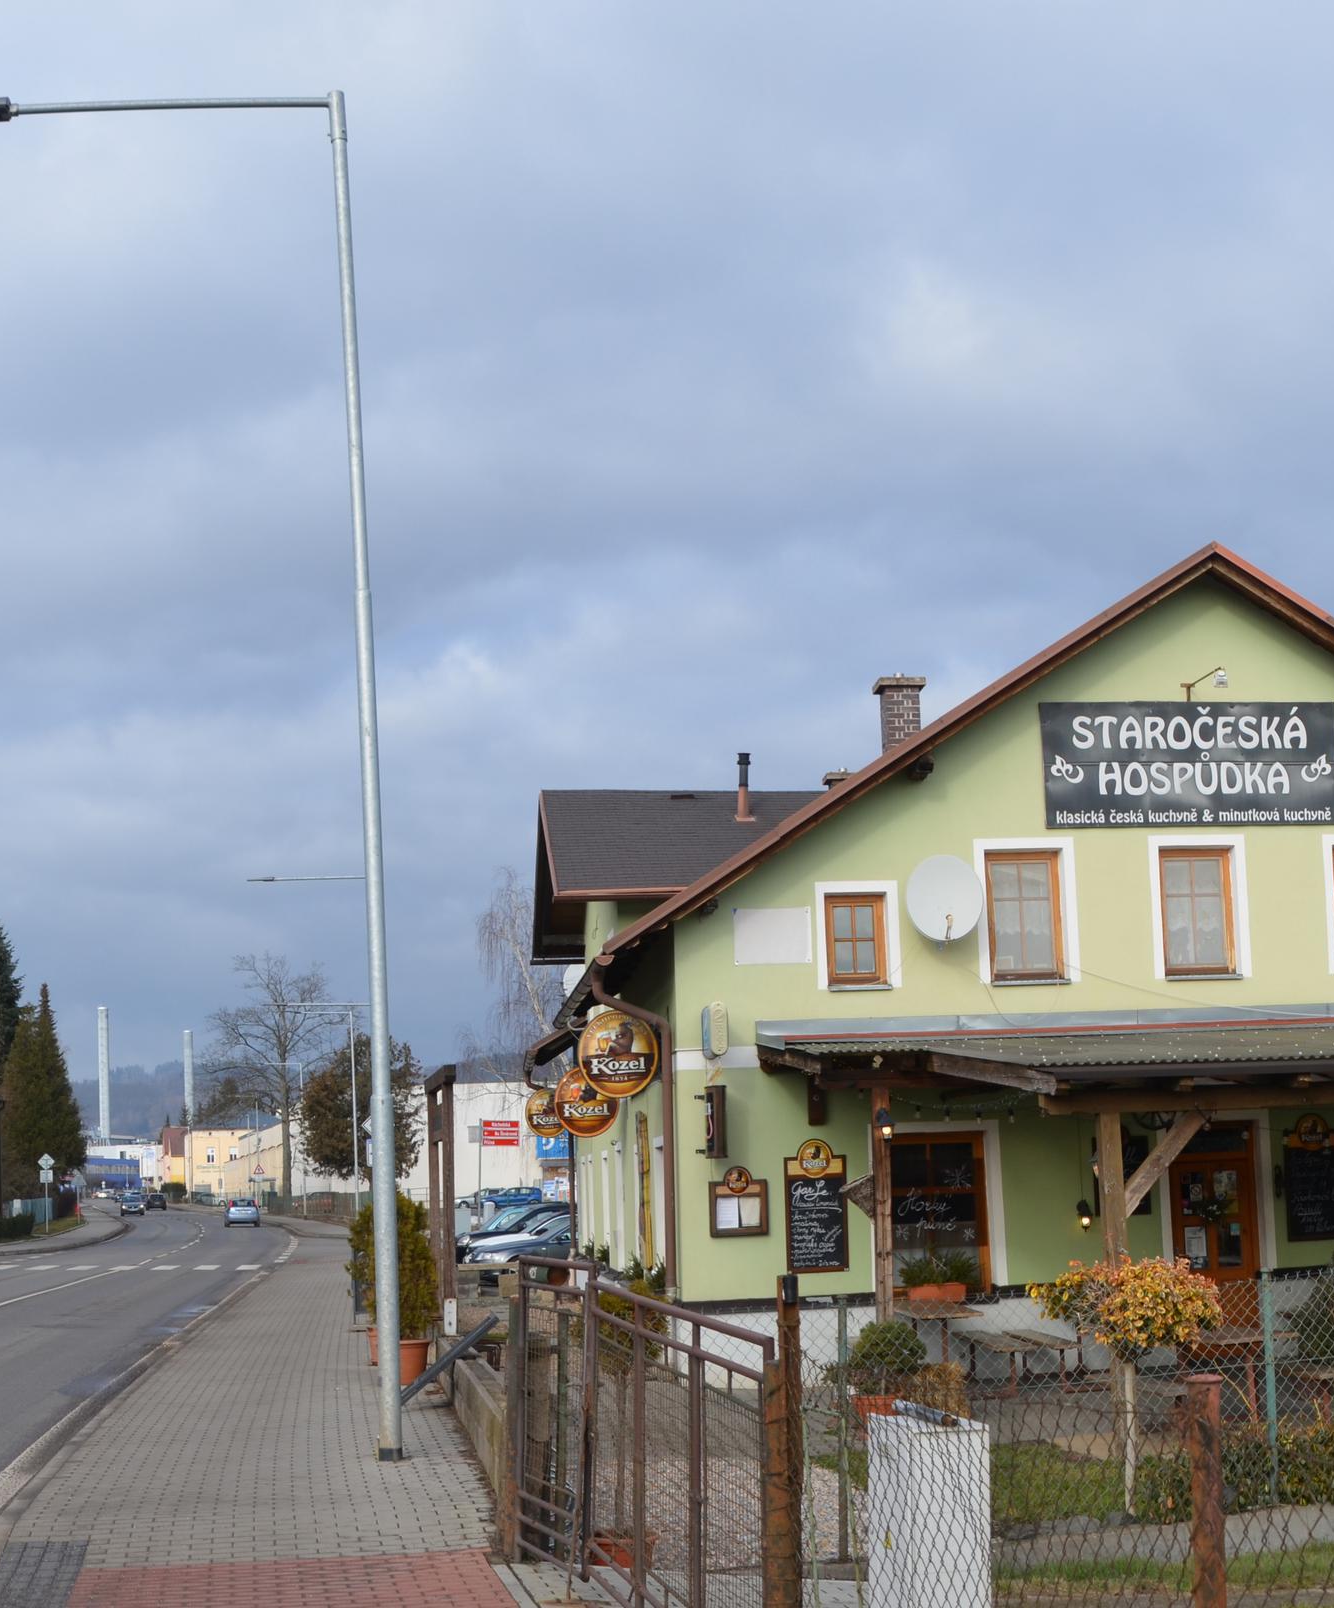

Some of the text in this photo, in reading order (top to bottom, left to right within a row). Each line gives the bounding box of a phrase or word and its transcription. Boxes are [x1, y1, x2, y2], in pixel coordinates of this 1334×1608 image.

[1072, 706, 1308, 750] STAROČESKÁ
[1098, 751, 1291, 796] HOSPŮDKA
[1056, 807, 1332, 824] klasická česká kuchyně & minutková kuchyně
[590, 1056, 646, 1075] Kozel
[563, 1102, 611, 1118] Kozel
[803, 1159, 827, 1169] Kozel
